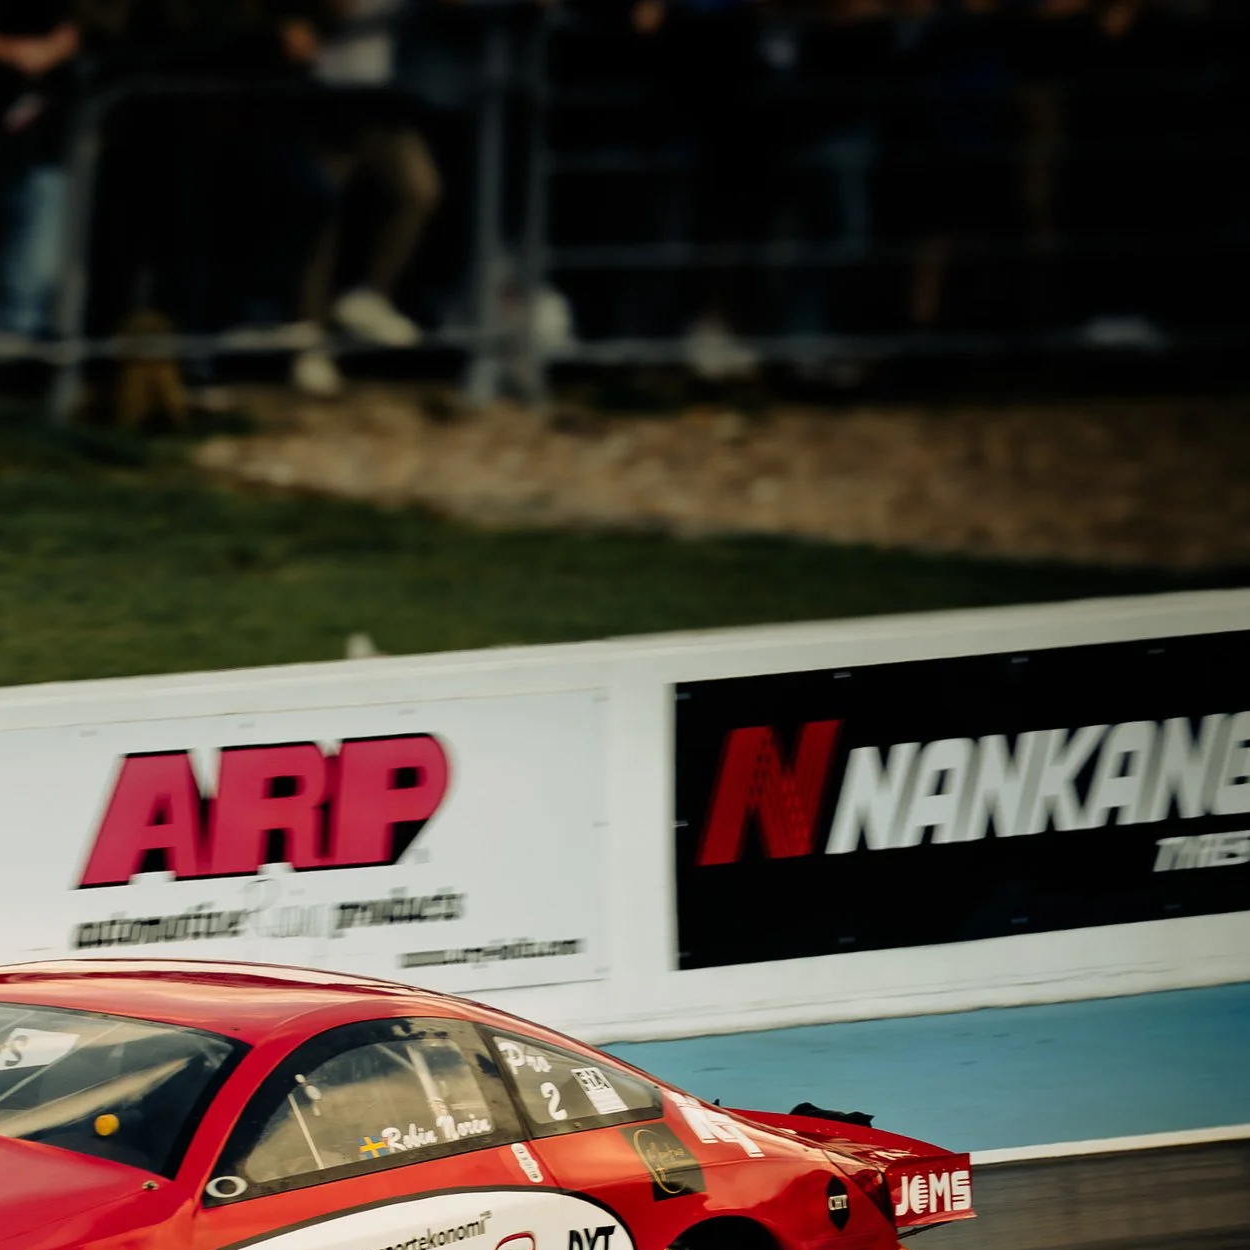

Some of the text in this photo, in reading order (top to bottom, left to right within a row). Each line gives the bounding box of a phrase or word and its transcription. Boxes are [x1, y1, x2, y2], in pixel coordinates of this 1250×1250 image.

[72, 732, 452, 889] ARP
[825, 710, 1250, 856] NANKANG
[539, 1082, 569, 1121] 2
